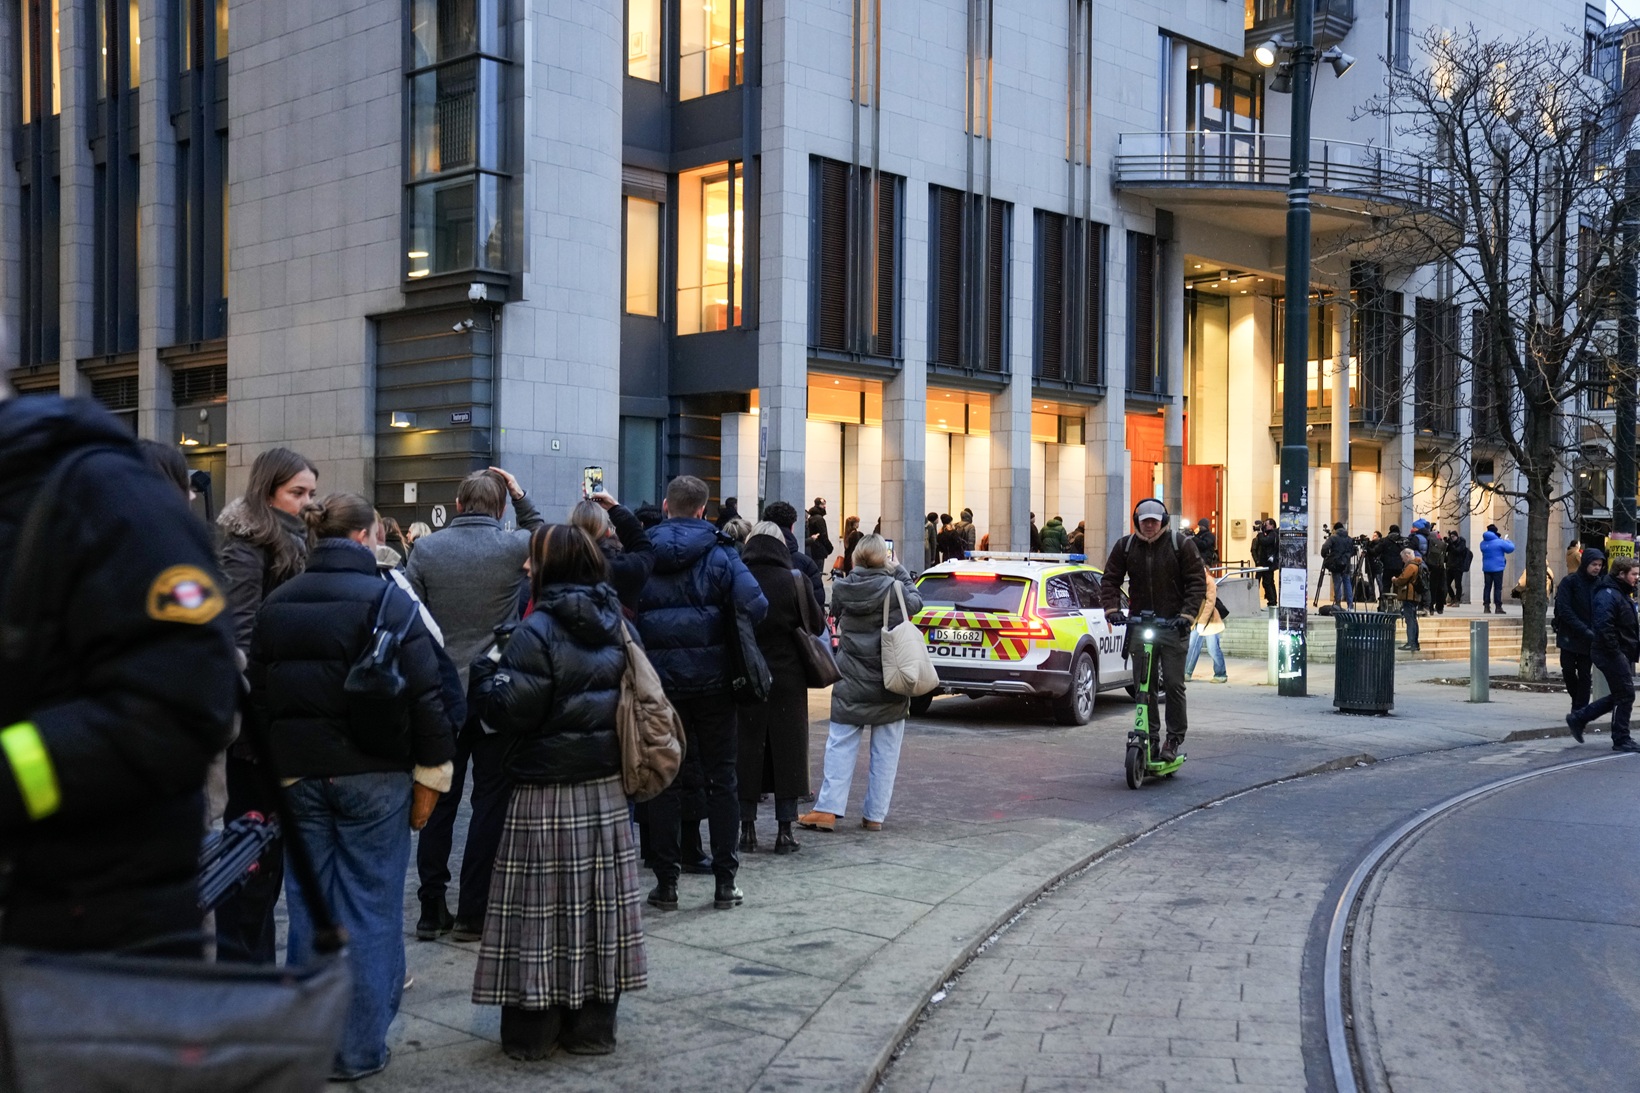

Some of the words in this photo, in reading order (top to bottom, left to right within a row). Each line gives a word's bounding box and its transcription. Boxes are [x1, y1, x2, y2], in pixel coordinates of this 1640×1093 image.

[936, 630, 949, 640] DS
[953, 631, 980, 641] 16682
[1099, 634, 1123, 655] POLITI
[926, 645, 986, 659] POLITI
